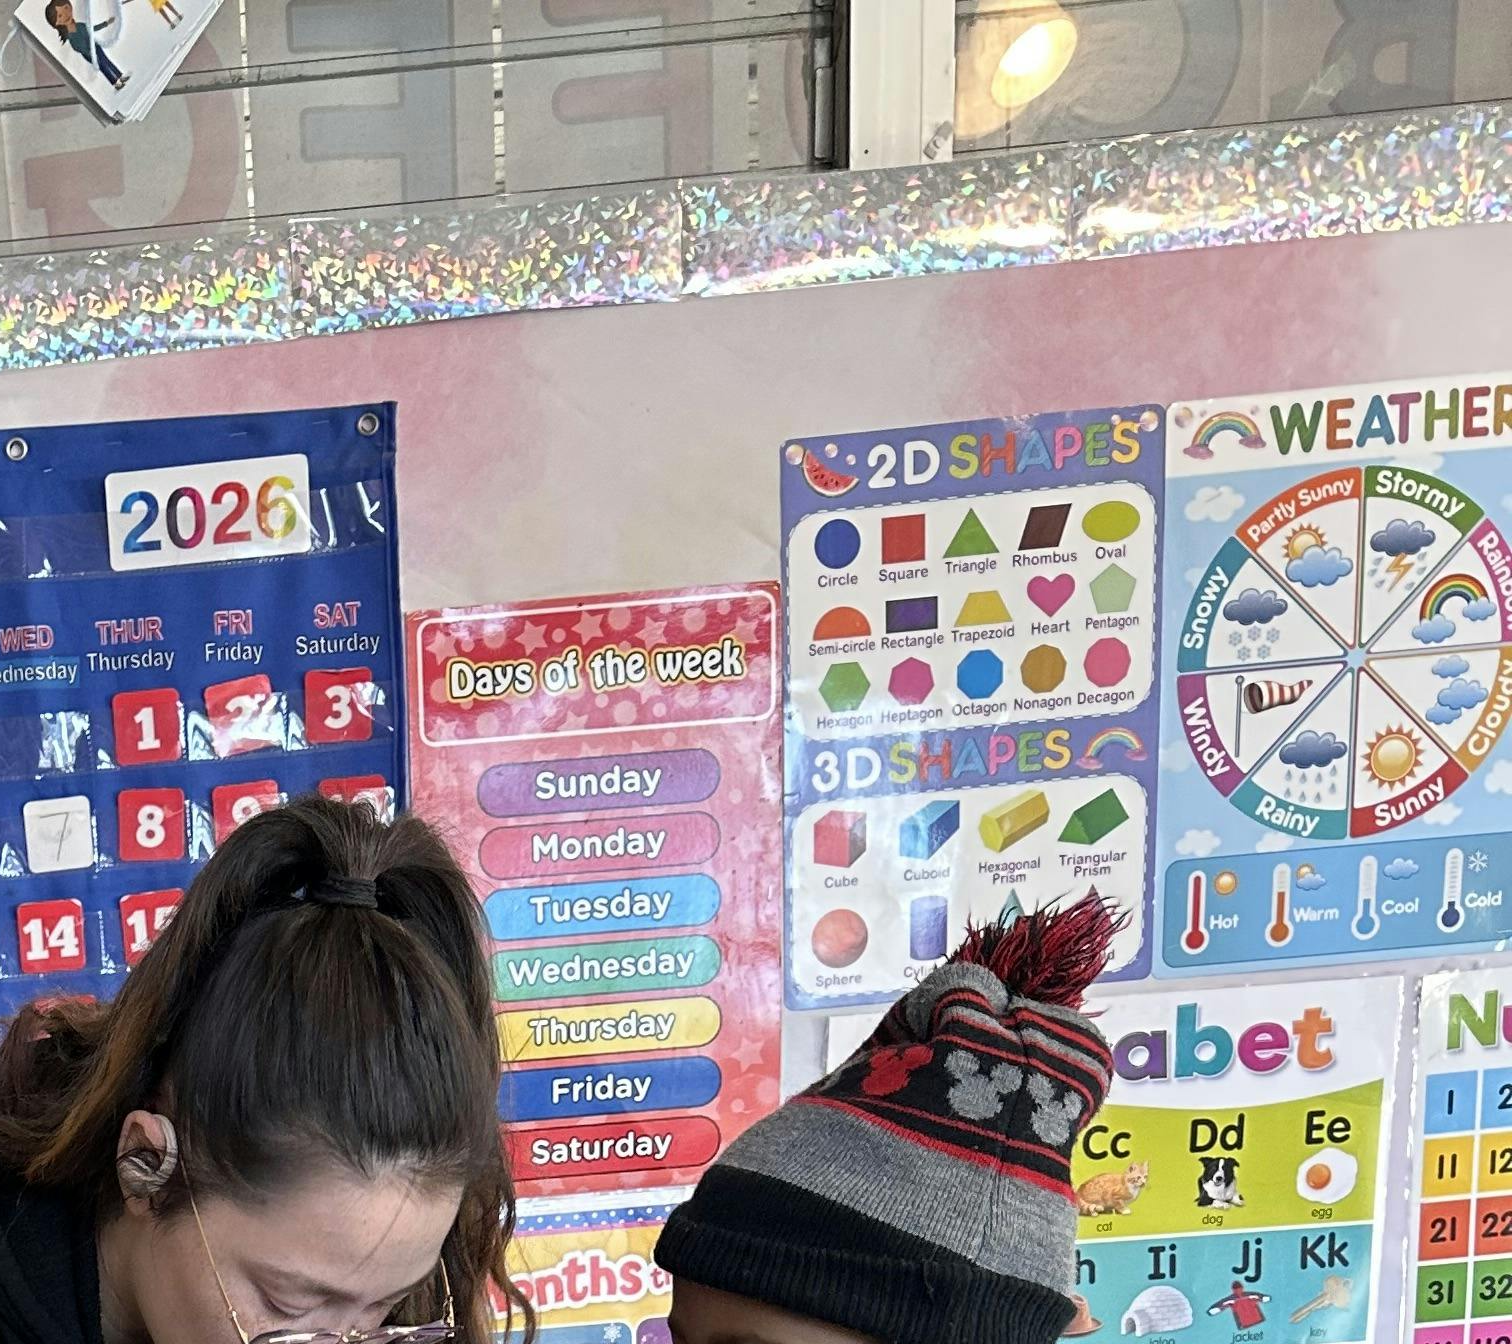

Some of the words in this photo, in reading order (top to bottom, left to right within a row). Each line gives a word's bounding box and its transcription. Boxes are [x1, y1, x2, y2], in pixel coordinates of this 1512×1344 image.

[866, 439, 941, 490] 2D
[948, 421, 1141, 480] SHAPES
[1375, 470, 1465, 518] Stormy
[119, 475, 297, 555] 2026
[1248, 499, 1297, 542] Partly
[1298, 478, 1354, 506] Sunny
[1012, 550, 1077, 567] Rhombus
[1095, 545, 1126, 560] Oval
[878, 565, 929, 583] Square
[945, 557, 997, 575] Triangle
[817, 573, 858, 588] Circle
[1184, 565, 1226, 649] Snowy
[95, 616, 163, 645] THUR
[213, 609, 253, 636] FRI
[313, 601, 361, 629] SAT
[1031, 619, 1070, 634] Heart
[1085, 614, 1139, 632] Pentagon
[881, 632, 944, 650] Rectangle
[951, 625, 1015, 643] Trapezoid
[86, 648, 175, 673] Thursday
[204, 639, 264, 665] Friday
[295, 631, 380, 657] Saturday
[808, 639, 876, 657] Semi-circle
[451, 660, 533, 699] Days
[543, 653, 578, 691] of
[589, 647, 646, 690] the
[655, 641, 743, 681] week
[1013, 694, 1072, 711] Nonagon
[1077, 688, 1134, 706] Decagon
[132, 707, 161, 751] 1
[323, 684, 352, 729] 3
[881, 707, 943, 725] Heptagon
[952, 701, 1008, 717] Octagon
[816, 713, 873, 730] Hexagon
[1183, 695, 1231, 778] Windy
[811, 747, 882, 793] 3D
[888, 728, 1071, 785] SHAPES
[535, 765, 662, 801] Sunday
[1374, 777, 1445, 827] Sunny
[1255, 794, 1320, 835] Rainy
[135, 804, 166, 848] 8
[38, 811, 74, 863] 7
[532, 828, 666, 864] Monday
[978, 857, 1041, 875] Hexagonal
[1059, 850, 1128, 867] Triangular
[903, 867, 950, 882] Cuboid
[992, 871, 1027, 884] Prism
[1073, 864, 1111, 878] Prism
[824, 875, 858, 889] Cube
[529, 889, 671, 925] Tuesday
[1381, 898, 1419, 916] Cool
[1465, 891, 1502, 908] Cold
[1210, 912, 1240, 930] Hot
[1292, 905, 1339, 923] Warm
[22, 915, 79, 960] 14
[508, 949, 696, 987] Wednesday
[816, 972, 862, 989] Sphere
[528, 1011, 676, 1046] Thursday
[551, 1072, 651, 1104] Friday
[1189, 1112, 1245, 1153] Dd
[1305, 1110, 1351, 1145] Ee
[531, 1131, 673, 1166] Saturday
[1083, 1125, 1131, 1160] Cc
[1202, 1213, 1223, 1226] dog
[1311, 1206, 1332, 1219] egg
[1096, 1221, 1113, 1232] cat
[1430, 1216, 1457, 1243] 21
[1232, 1237, 1262, 1283] Jj
[1300, 1232, 1350, 1270] Kk
[1427, 1279, 1454, 1306] 31
[1479, 1274, 1512, 1301] 32
[1231, 1330, 1264, 1344] jacket
[1310, 1326, 1327, 1337] key
